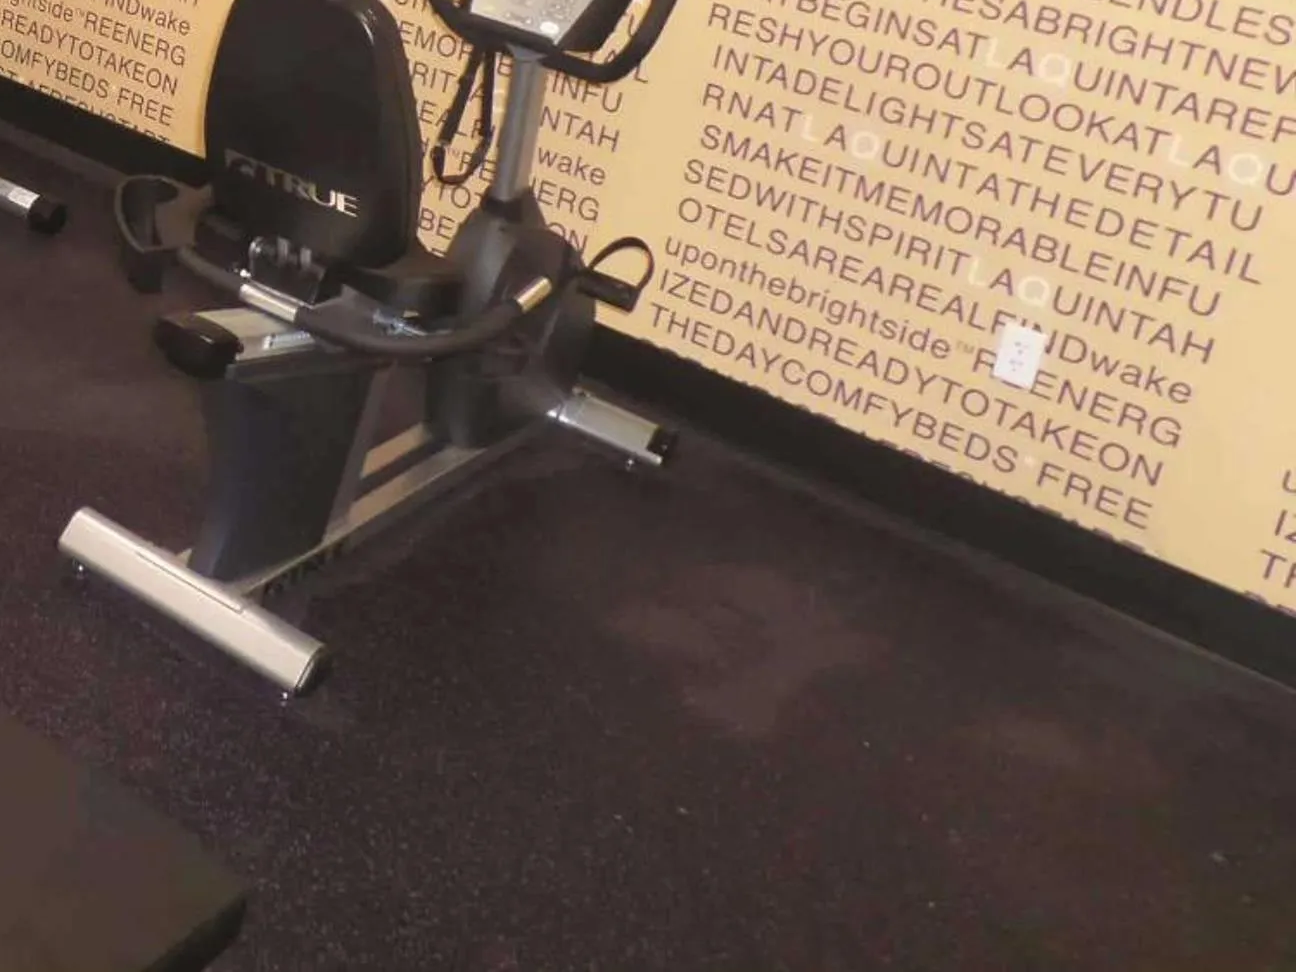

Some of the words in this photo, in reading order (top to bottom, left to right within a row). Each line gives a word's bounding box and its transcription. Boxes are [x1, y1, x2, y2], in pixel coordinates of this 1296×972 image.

[116, 87, 173, 129] FREE
[259, 161, 360, 218] TRUE
[711, 46, 1263, 241] INTADELIGHTSATEVERYTU
[698, 124, 1220, 324] SMAKEITMEMORABLEINFU
[645, 303, 1020, 478] THEDAYCOMFYBEDS
[1033, 462, 1154, 534] FREE
[656, 268, 1164, 492] IZEDANDREADYTOTAKEON
